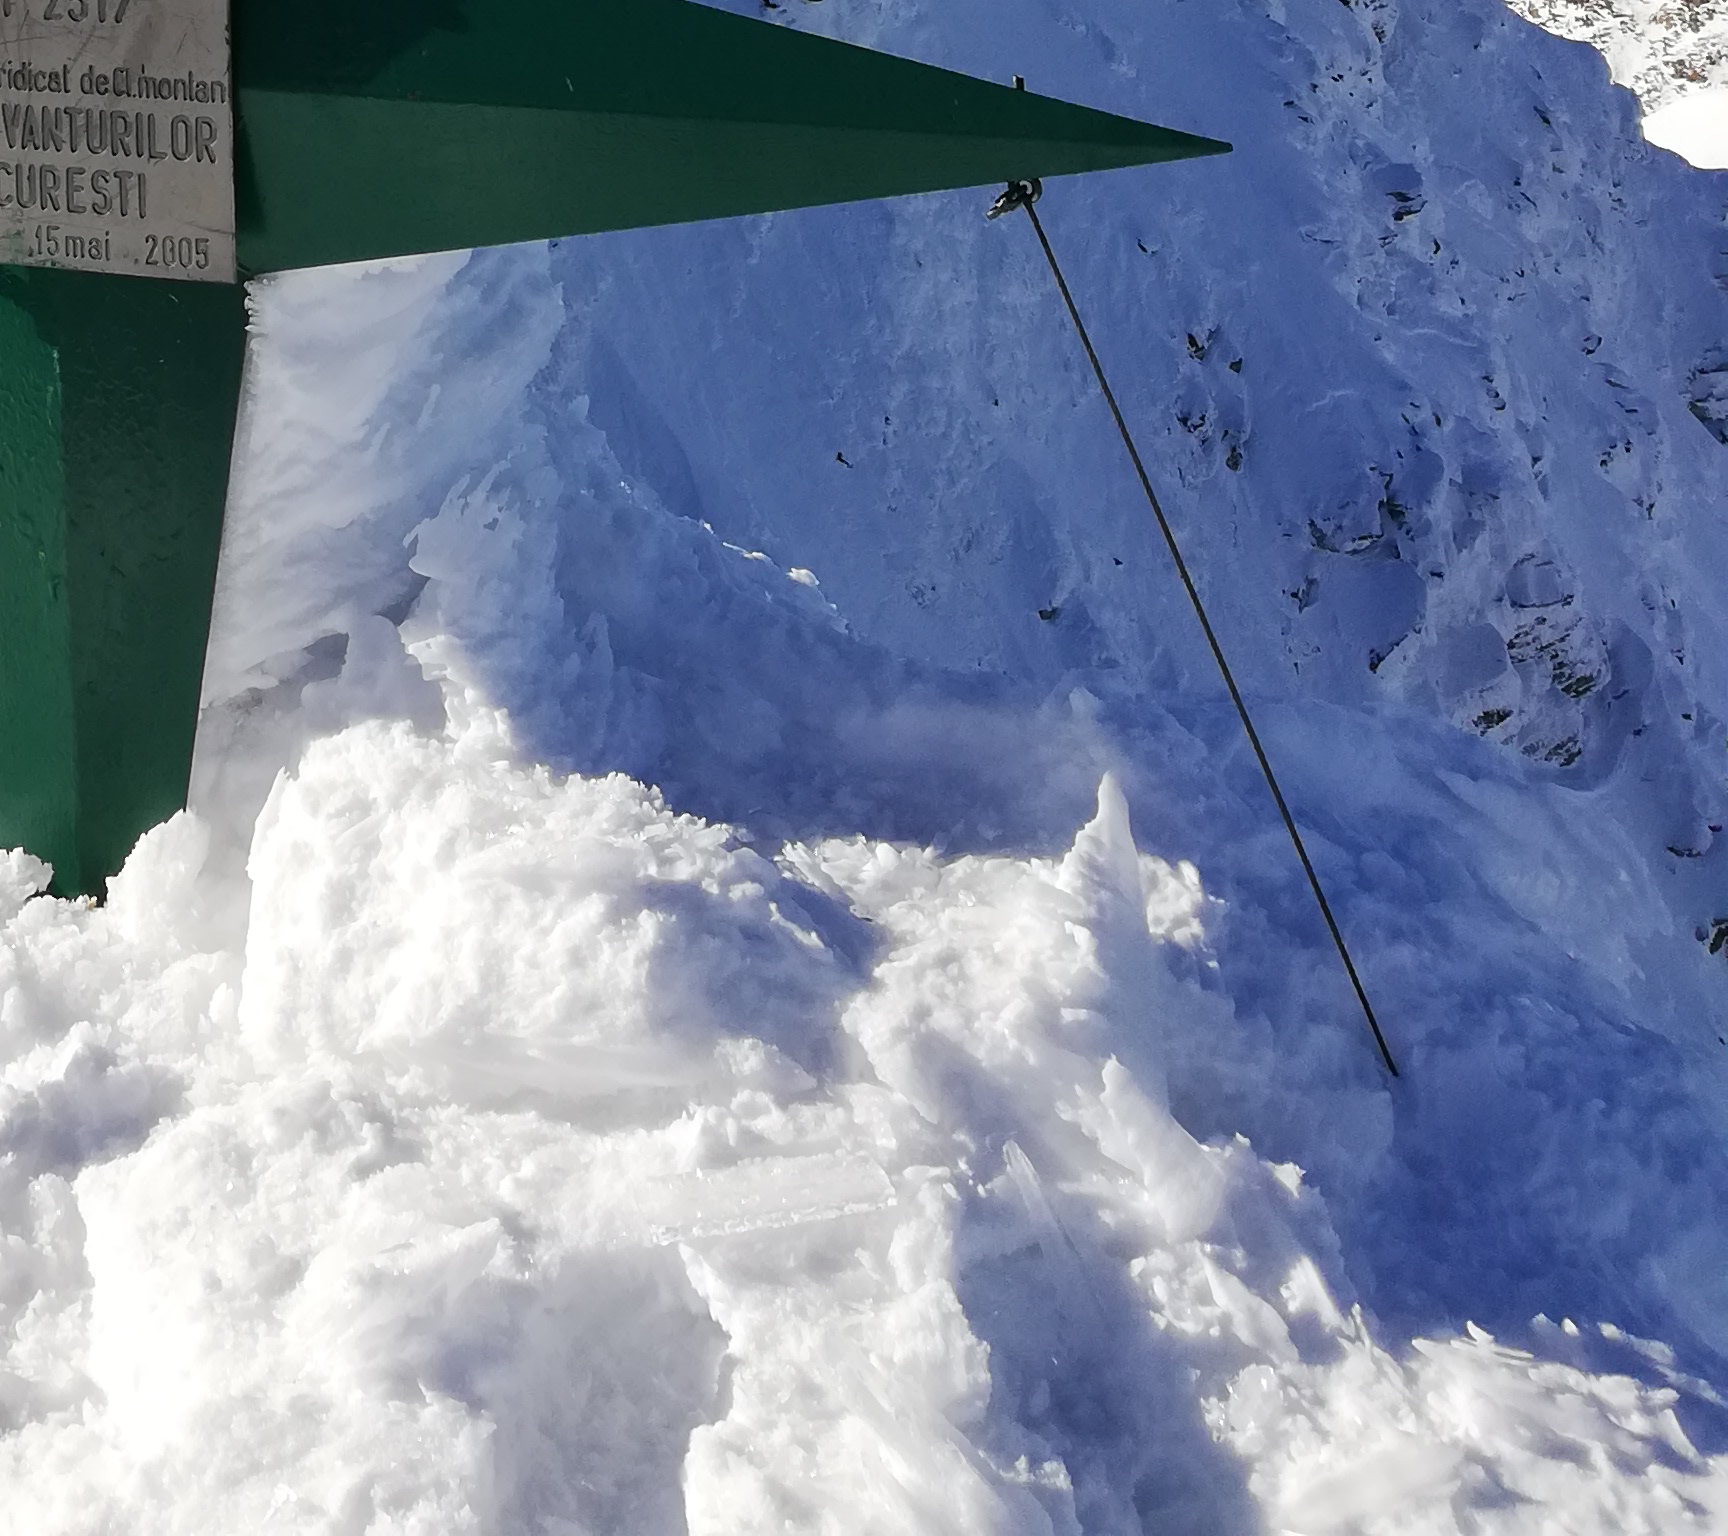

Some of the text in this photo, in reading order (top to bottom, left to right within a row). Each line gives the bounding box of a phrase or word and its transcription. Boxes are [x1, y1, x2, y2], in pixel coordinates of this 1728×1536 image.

[79, 64, 110, 96] de
[2, 102, 218, 165] VANTURILOR
[65, 230, 112, 262] mai
